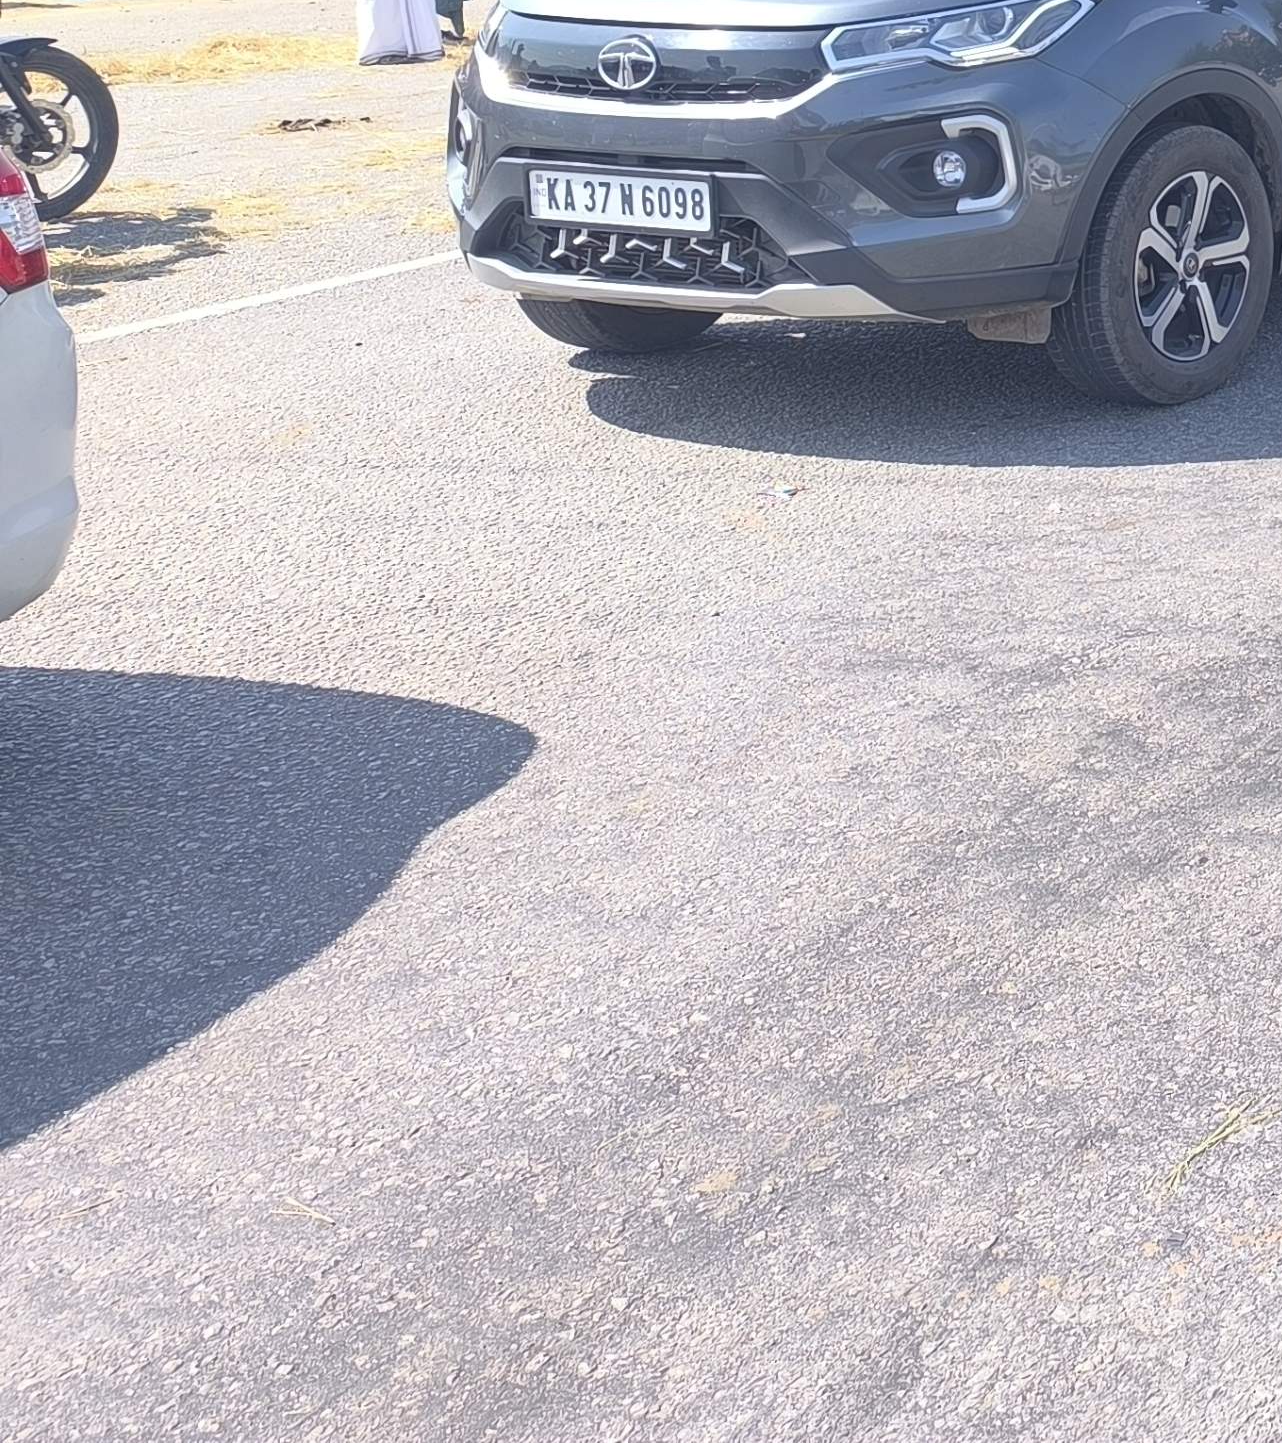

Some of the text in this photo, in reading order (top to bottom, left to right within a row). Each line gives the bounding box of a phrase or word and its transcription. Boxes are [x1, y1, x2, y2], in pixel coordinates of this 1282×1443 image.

[547, 178, 704, 221] KA 37 N 6098
